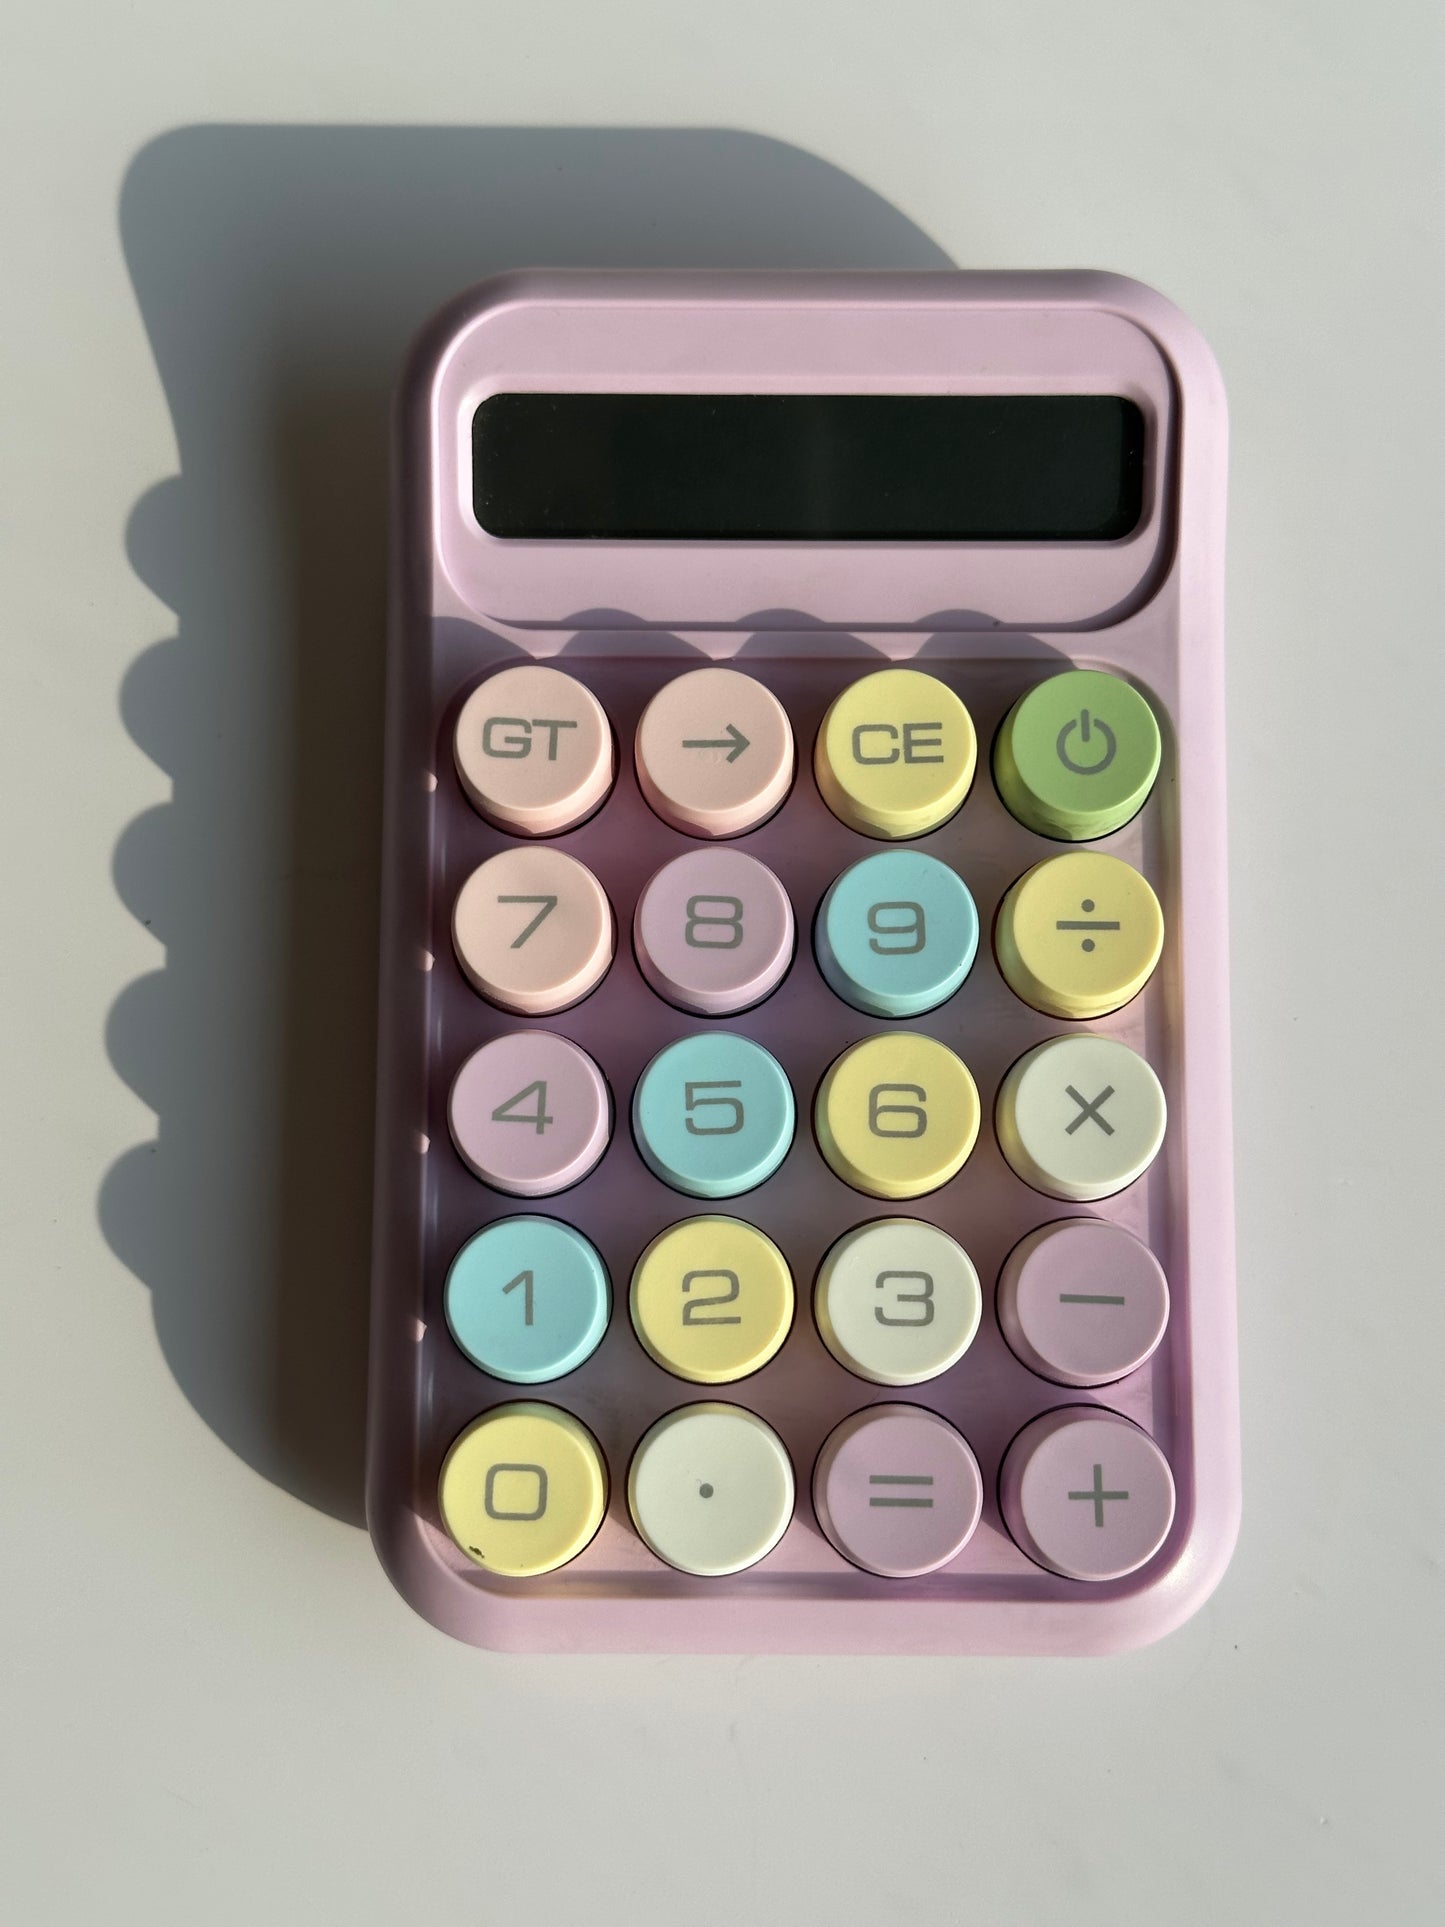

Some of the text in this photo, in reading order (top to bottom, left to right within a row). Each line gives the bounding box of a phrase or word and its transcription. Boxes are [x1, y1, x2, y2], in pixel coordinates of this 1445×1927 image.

[483, 718, 577, 760] GT
[852, 723, 944, 765] CE
[498, 896, 558, 948] 7
[685, 897, 743, 949] 8
[869, 903, 926, 955] 9
[493, 1082, 553, 1134] 4
[686, 1082, 744, 1135] 5
[870, 1085, 927, 1138] 6
[503, 1271, 533, 1326] 1
[682, 1271, 741, 1325] 2
[876, 1272, 934, 1327] 3
[486, 1465, 548, 1521] 0
